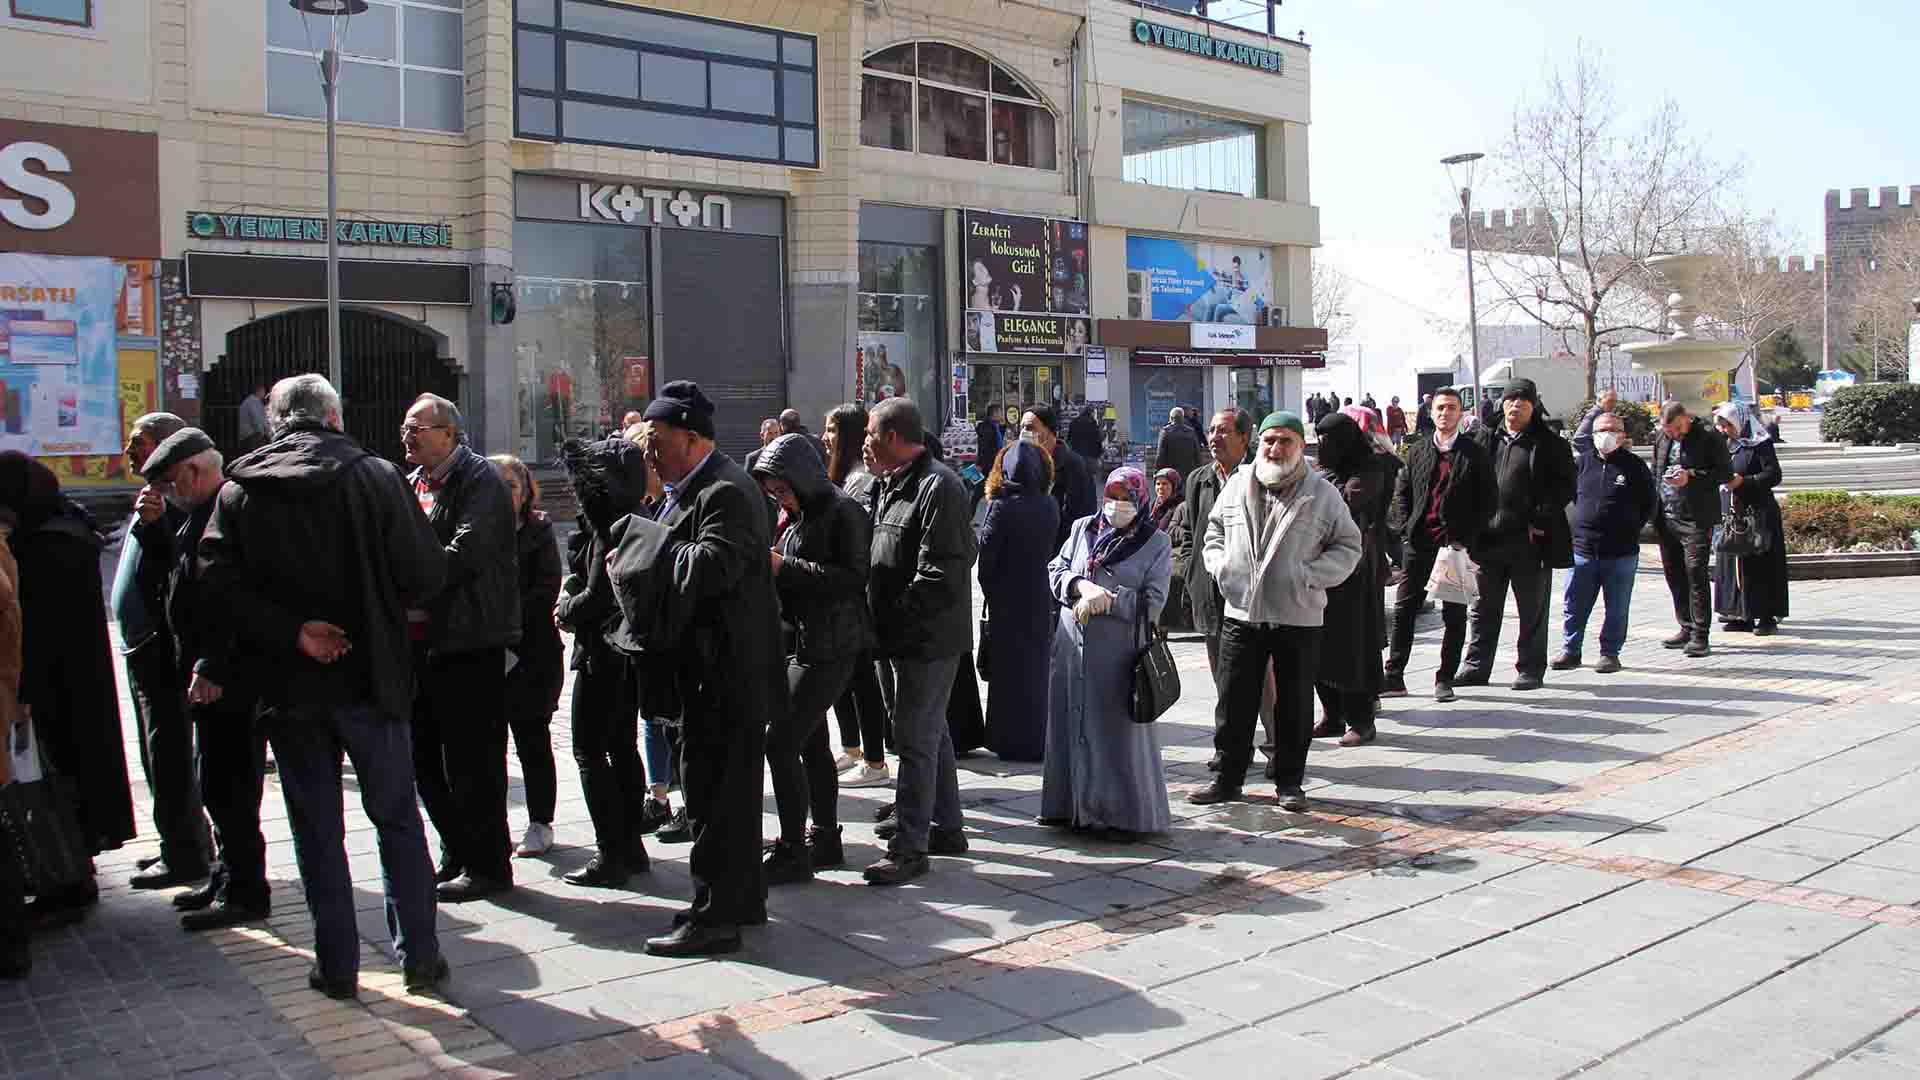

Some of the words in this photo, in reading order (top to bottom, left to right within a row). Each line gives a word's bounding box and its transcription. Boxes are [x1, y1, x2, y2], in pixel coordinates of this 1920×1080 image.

[1151, 24, 1213, 56] YEMEN
[0, 141, 76, 230] S
[219, 215, 322, 241] YEMEN
[335, 219, 449, 246] KAHVESİ
[1011, 259, 1035, 274] Gizli
[1003, 318, 1057, 334] ELEGANCE
[1164, 355, 1180, 365] Türk
[1182, 355, 1211, 365] Telekom
[1260, 356, 1274, 366] Türk
[1274, 356, 1301, 367] Telekom
